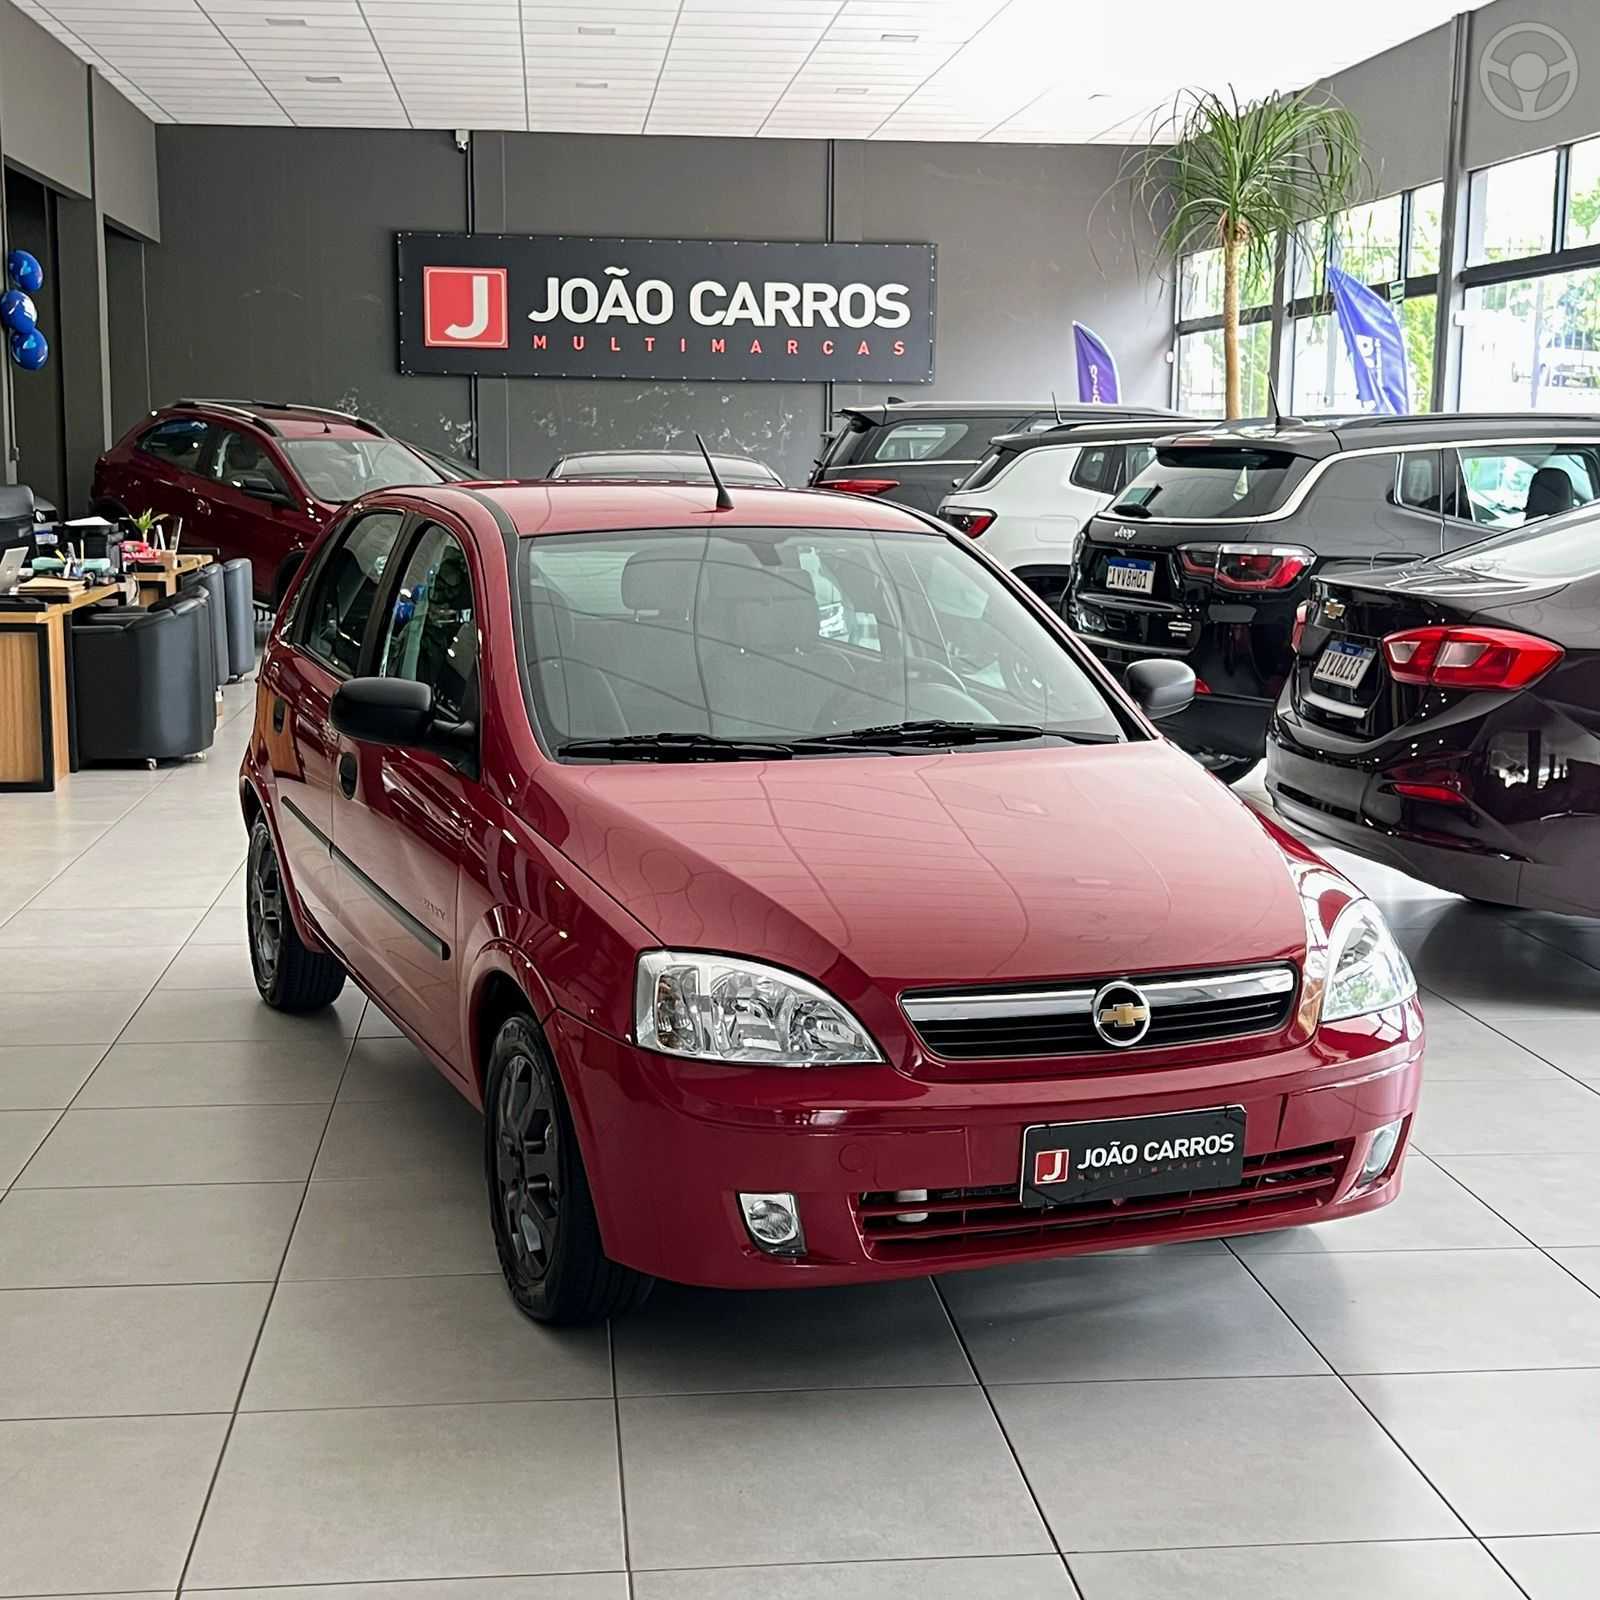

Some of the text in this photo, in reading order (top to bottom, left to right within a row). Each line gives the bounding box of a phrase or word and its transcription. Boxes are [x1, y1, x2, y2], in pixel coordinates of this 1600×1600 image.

[444, 275, 488, 340] J
[527, 266, 911, 329] JOÃO CARROS
[533, 334, 906, 356] MULTIMARCAS
[1041, 1152, 1062, 1181] J
[1077, 1133, 1235, 1170] JOÃO CARROS
